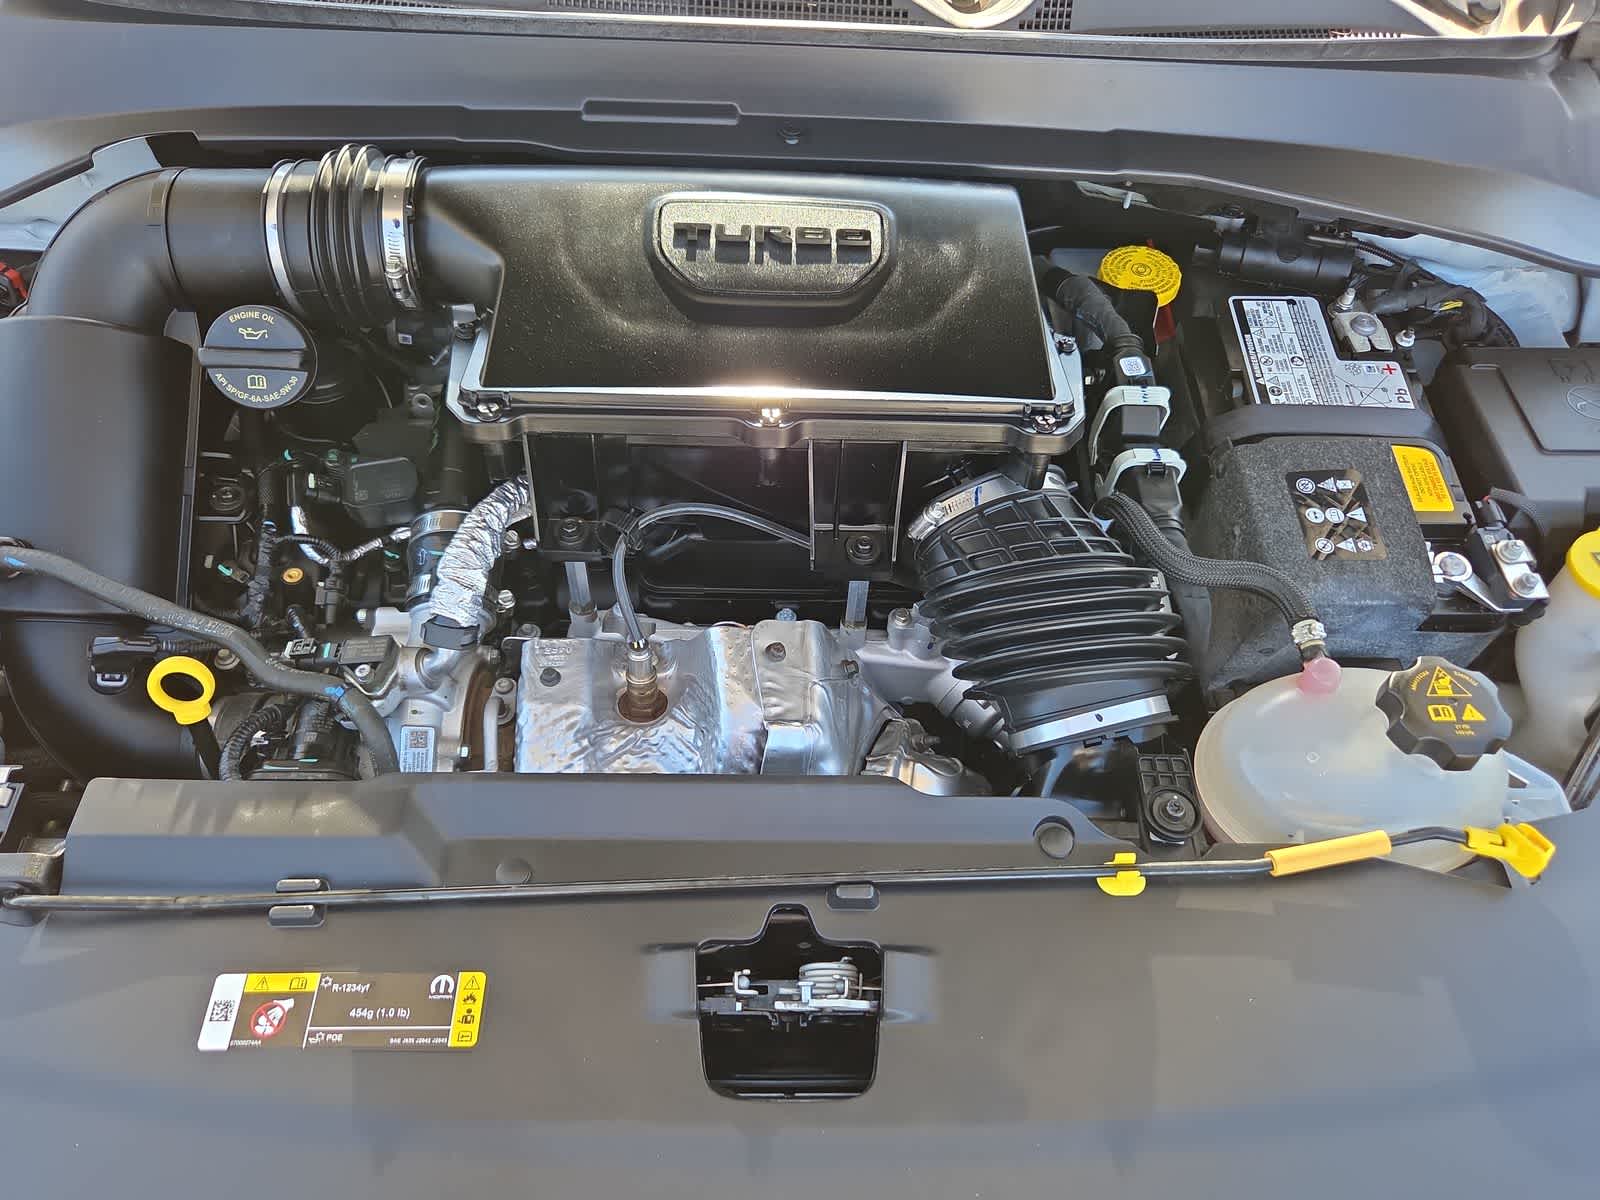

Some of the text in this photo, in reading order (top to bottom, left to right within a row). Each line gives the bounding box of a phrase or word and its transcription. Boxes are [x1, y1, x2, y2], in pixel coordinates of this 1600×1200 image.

[673, 223, 872, 264] TURBO
[228, 311, 275, 325] ENGINE OIL
[215, 373, 226, 387] API
[1395, 388, 1410, 404] Pb
[332, 983, 370, 993] R-1234yf
[350, 1007, 411, 1019] 454g (1.0 lb)
